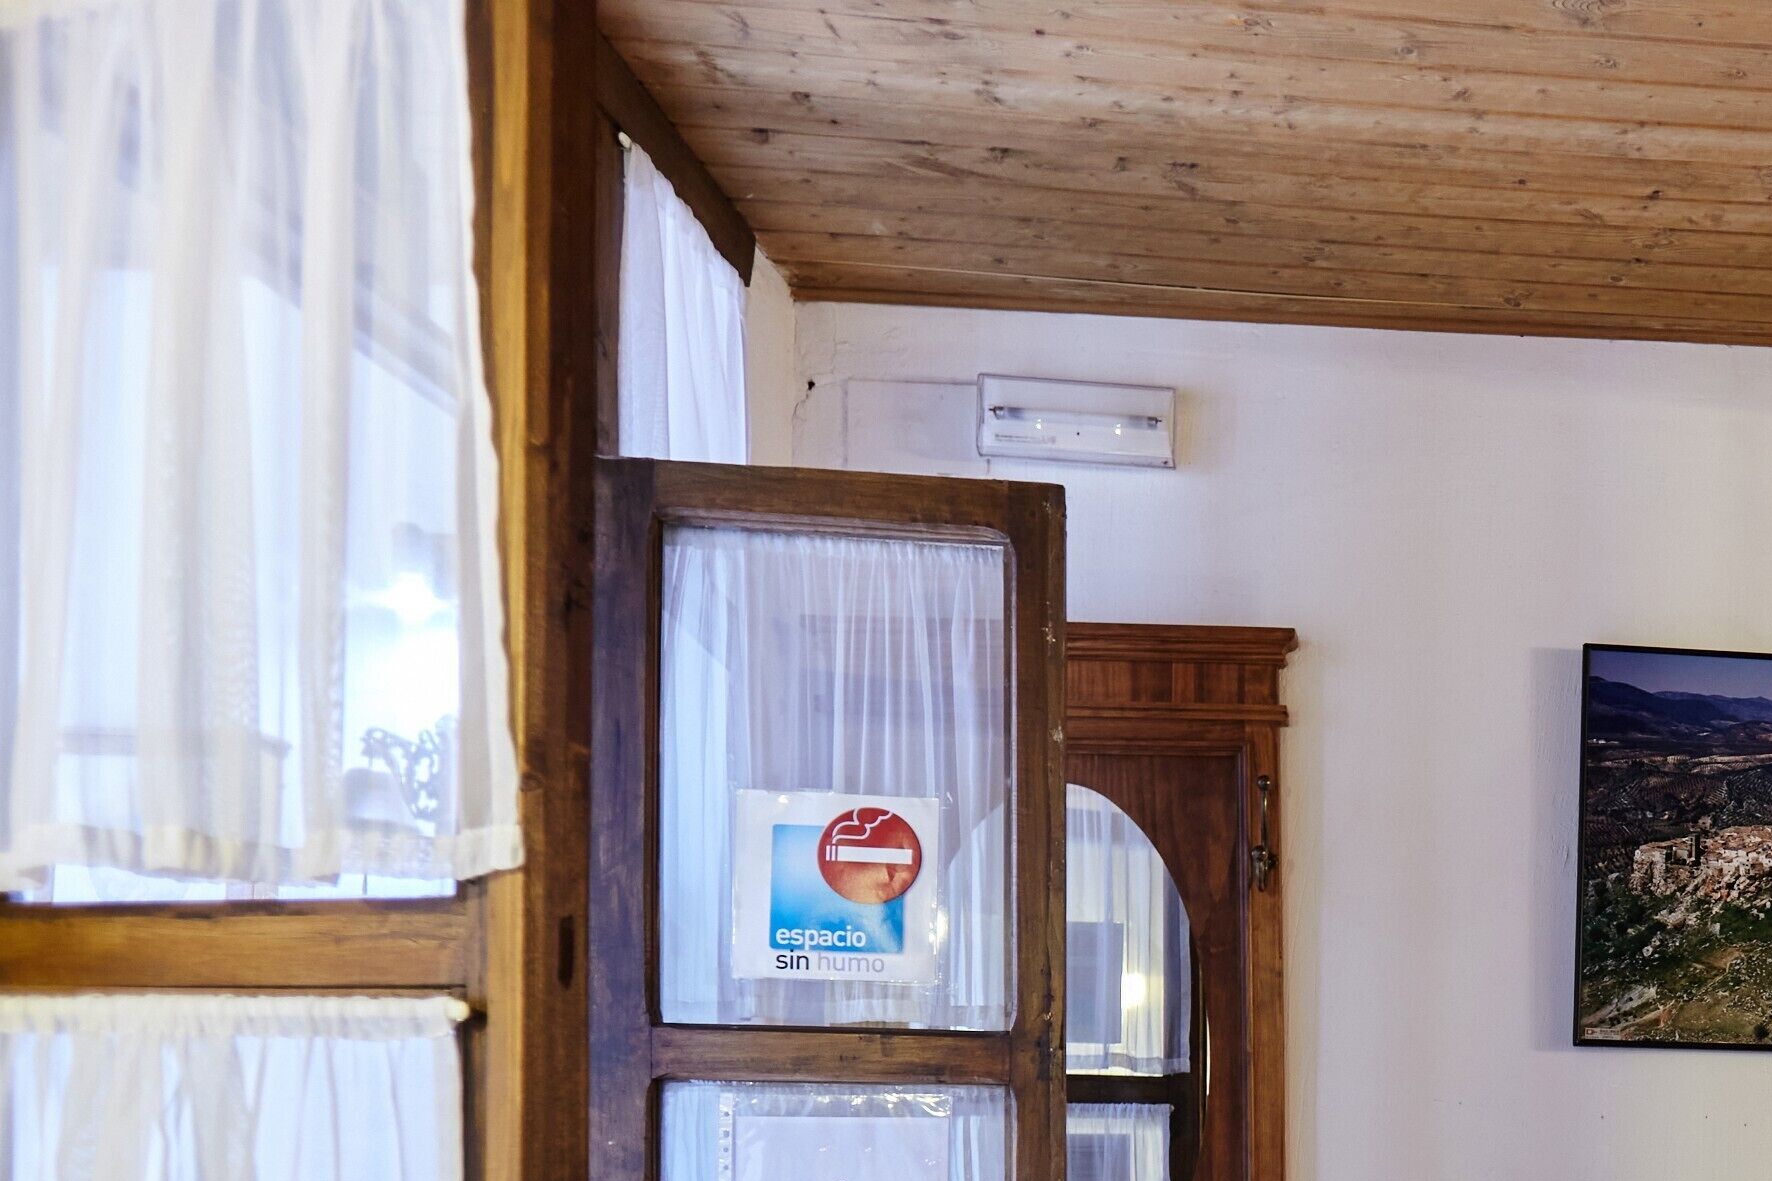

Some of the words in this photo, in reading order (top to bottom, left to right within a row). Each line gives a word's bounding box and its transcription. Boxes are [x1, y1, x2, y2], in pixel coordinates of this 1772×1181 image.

[775, 926, 866, 950] espacio
[775, 949, 810, 970] sin
[817, 952, 885, 973] humo
